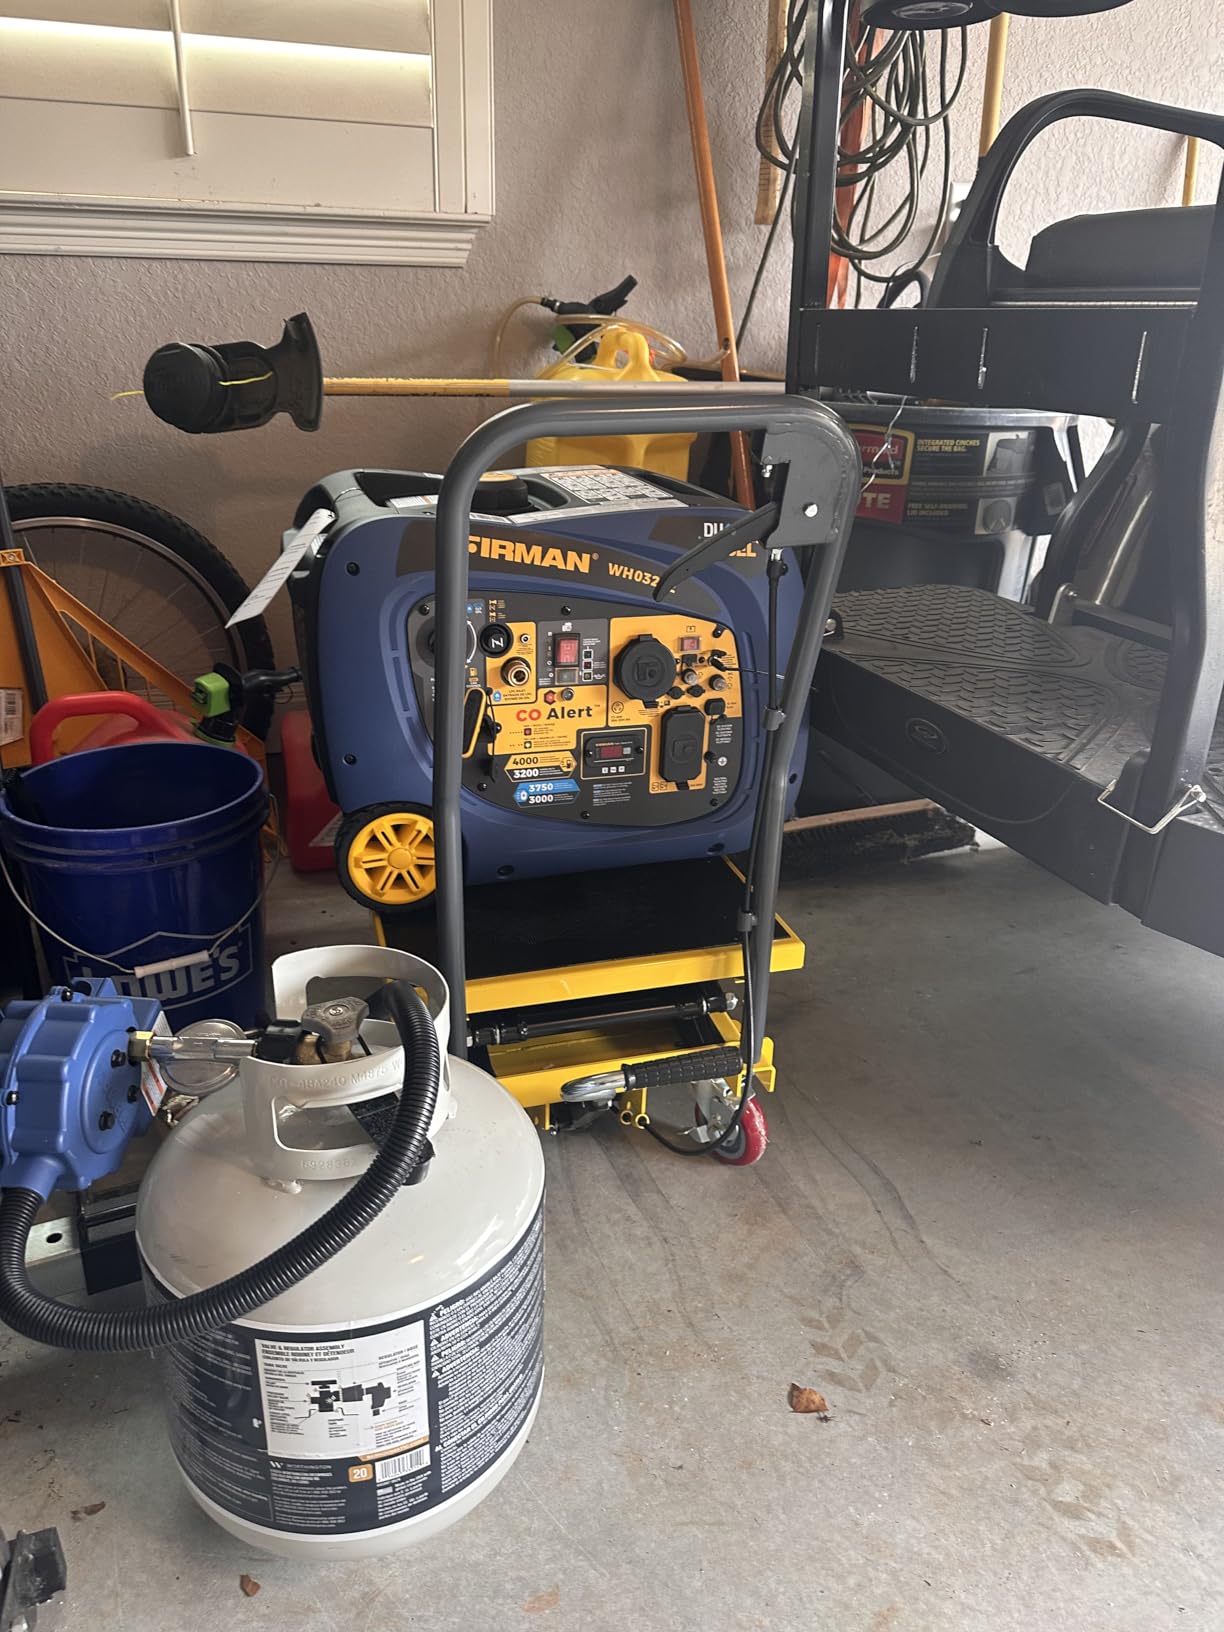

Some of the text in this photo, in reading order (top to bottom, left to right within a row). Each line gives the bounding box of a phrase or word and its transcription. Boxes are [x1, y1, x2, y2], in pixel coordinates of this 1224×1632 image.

[516, 706, 593, 722] CO Alert
[512, 756, 539, 766] 4000
[513, 768, 539, 778] 3200
[528, 783, 554, 792] 3750
[528, 794, 554, 804] 3000
[352, 1468, 368, 1479] 20
